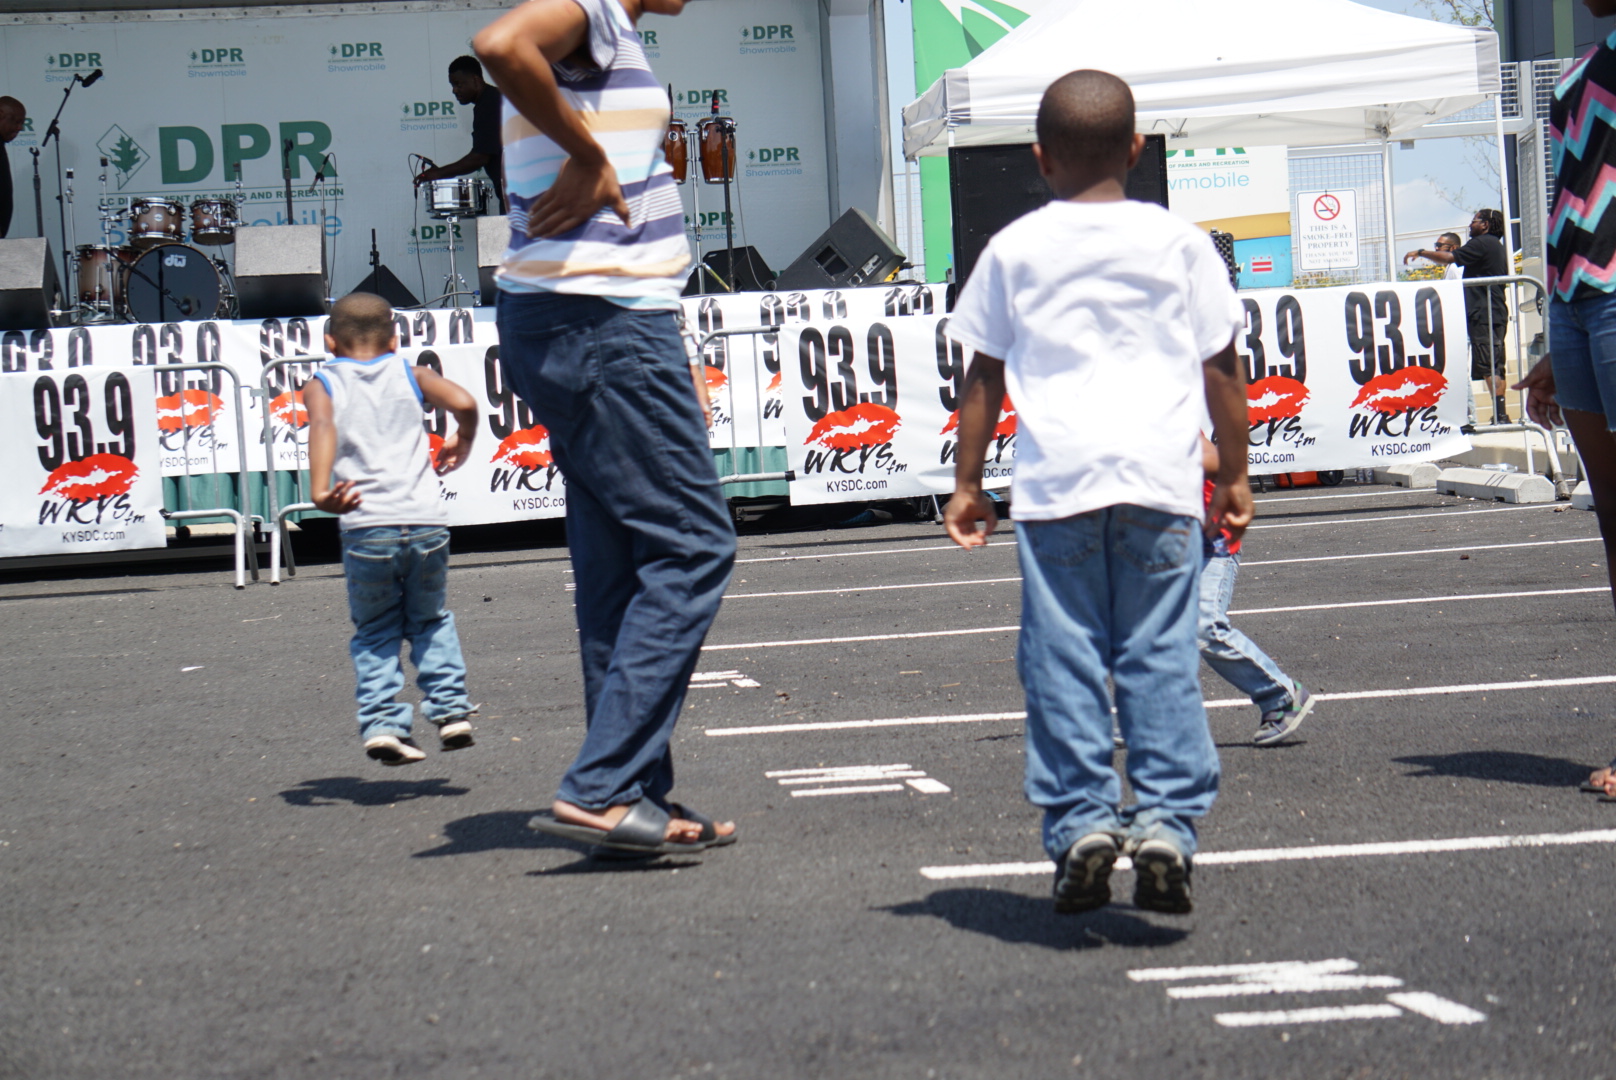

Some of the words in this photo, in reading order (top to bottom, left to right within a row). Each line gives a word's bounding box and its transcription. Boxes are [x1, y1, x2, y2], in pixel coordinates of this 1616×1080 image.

[752, 25, 794, 40] DPR
[201, 48, 244, 63] DPR
[341, 42, 383, 58] DPR
[739, 45, 796, 55] Showmobile
[59, 52, 102, 67] DPR
[188, 69, 247, 78] Showmobile
[328, 64, 386, 72] Showmobile
[45, 74, 105, 82] Showe
[688, 89, 728, 104] DPR
[414, 101, 455, 116] DPR
[674, 110, 731, 119] Showmoile
[400, 122, 458, 131] Showmobile
[159, 120, 338, 185] DPR
[759, 147, 800, 162] DPR
[745, 168, 803, 177] Showmobile
[250, 191, 273, 200] AND
[276, 188, 344, 198] RCREATION
[421, 224, 462, 240] DPR
[1310, 224, 1328, 232] THIS
[1302, 232, 1354, 240] SMOKE-FREE
[408, 245, 465, 254] Showmoile
[1308, 241, 1349, 249] PROPERTY
[1239, 295, 1307, 386] 3.9
[1345, 287, 1446, 386] 93.9
[799, 322, 898, 422] 93.9
[33, 371, 136, 473] 93.9
[1349, 405, 1438, 439] WKYS
[1371, 442, 1431, 457] KYSDC.com
[804, 442, 894, 475] WKYS
[1248, 451, 1295, 465] SDC.com
[490, 462, 567, 493] WKY
[826, 479, 888, 493] KYSDC.com
[39, 493, 131, 525] WKYS
[513, 496, 566, 511] KYSDC.co
[62, 529, 126, 544] KYSDC.com
